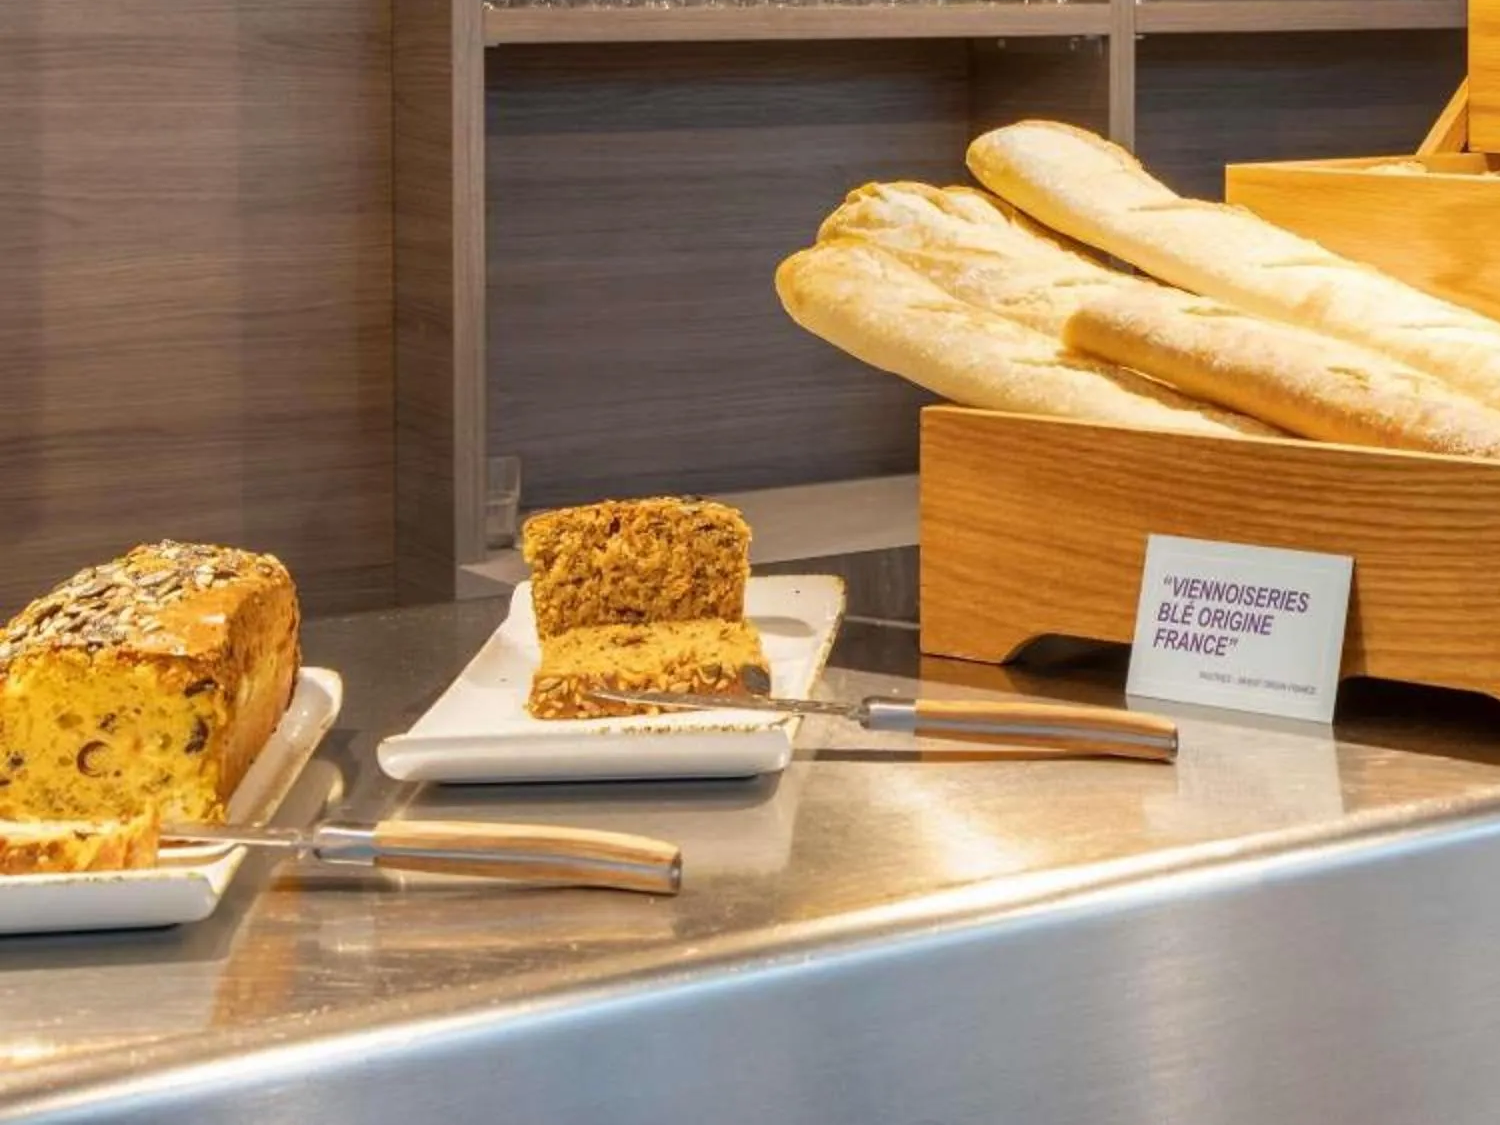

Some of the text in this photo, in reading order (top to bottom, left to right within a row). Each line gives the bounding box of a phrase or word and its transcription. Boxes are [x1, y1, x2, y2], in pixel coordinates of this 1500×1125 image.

[1163, 575, 1311, 614] “VIENNOISERIES
[1156, 600, 1275, 636] BLÉ ORIGINE
[1153, 627, 1239, 657] FRANCE”
